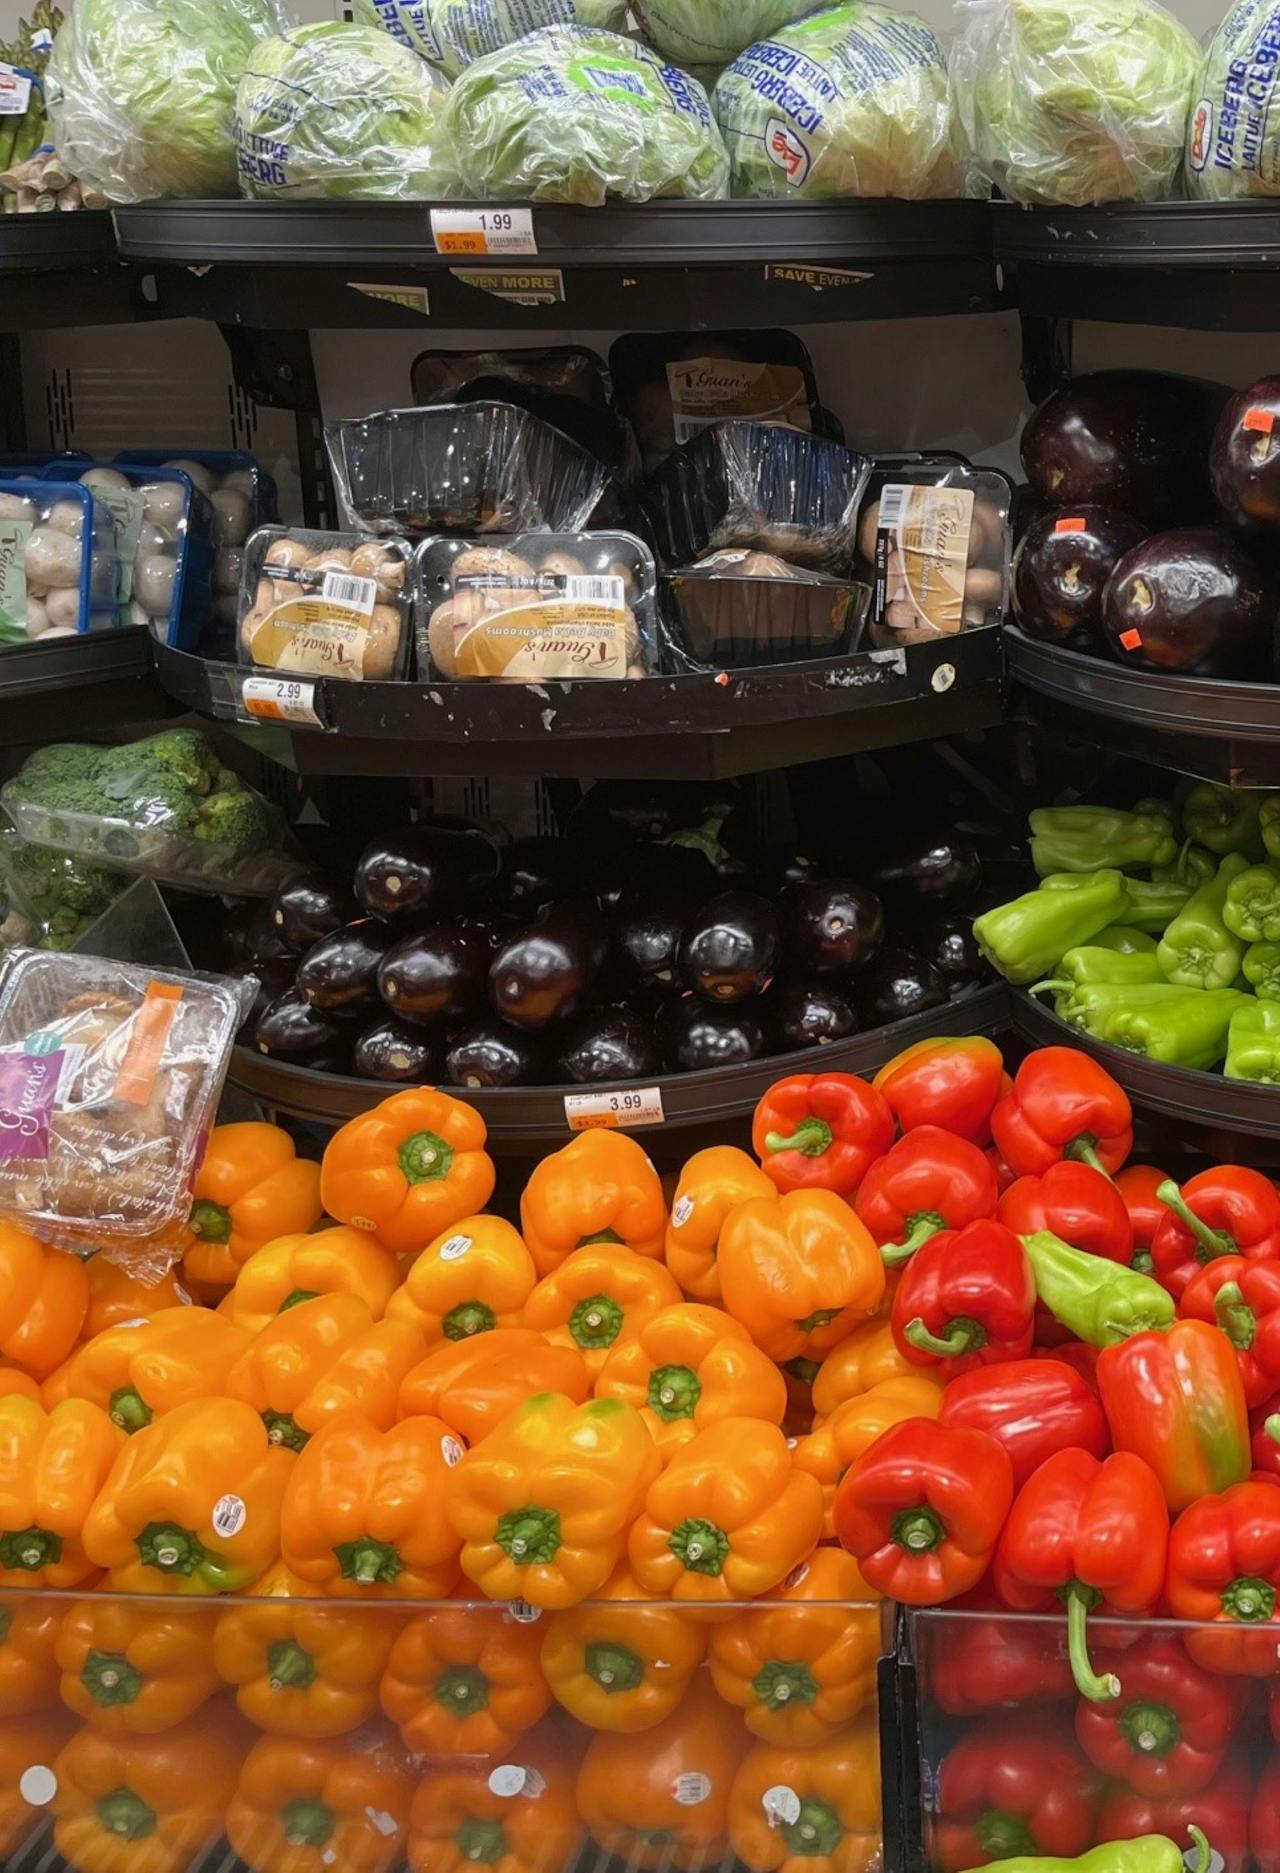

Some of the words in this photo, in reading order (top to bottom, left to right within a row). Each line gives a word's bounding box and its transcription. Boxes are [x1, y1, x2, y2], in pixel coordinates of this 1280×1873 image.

[751, 74, 824, 135] ICEBERG
[1214, 58, 1248, 170] ICEBERG
[1242, 114, 1263, 172] LAITUE
[479, 214, 512, 231] 1.99
[502, 276, 555, 289] MORE
[773, 268, 817, 284] SAVE
[485, 625, 553, 637] Mushrooms
[523, 640, 597, 663] Guan's
[277, 682, 301, 699] 2.99
[610, 1094, 642, 1111] 3.99
